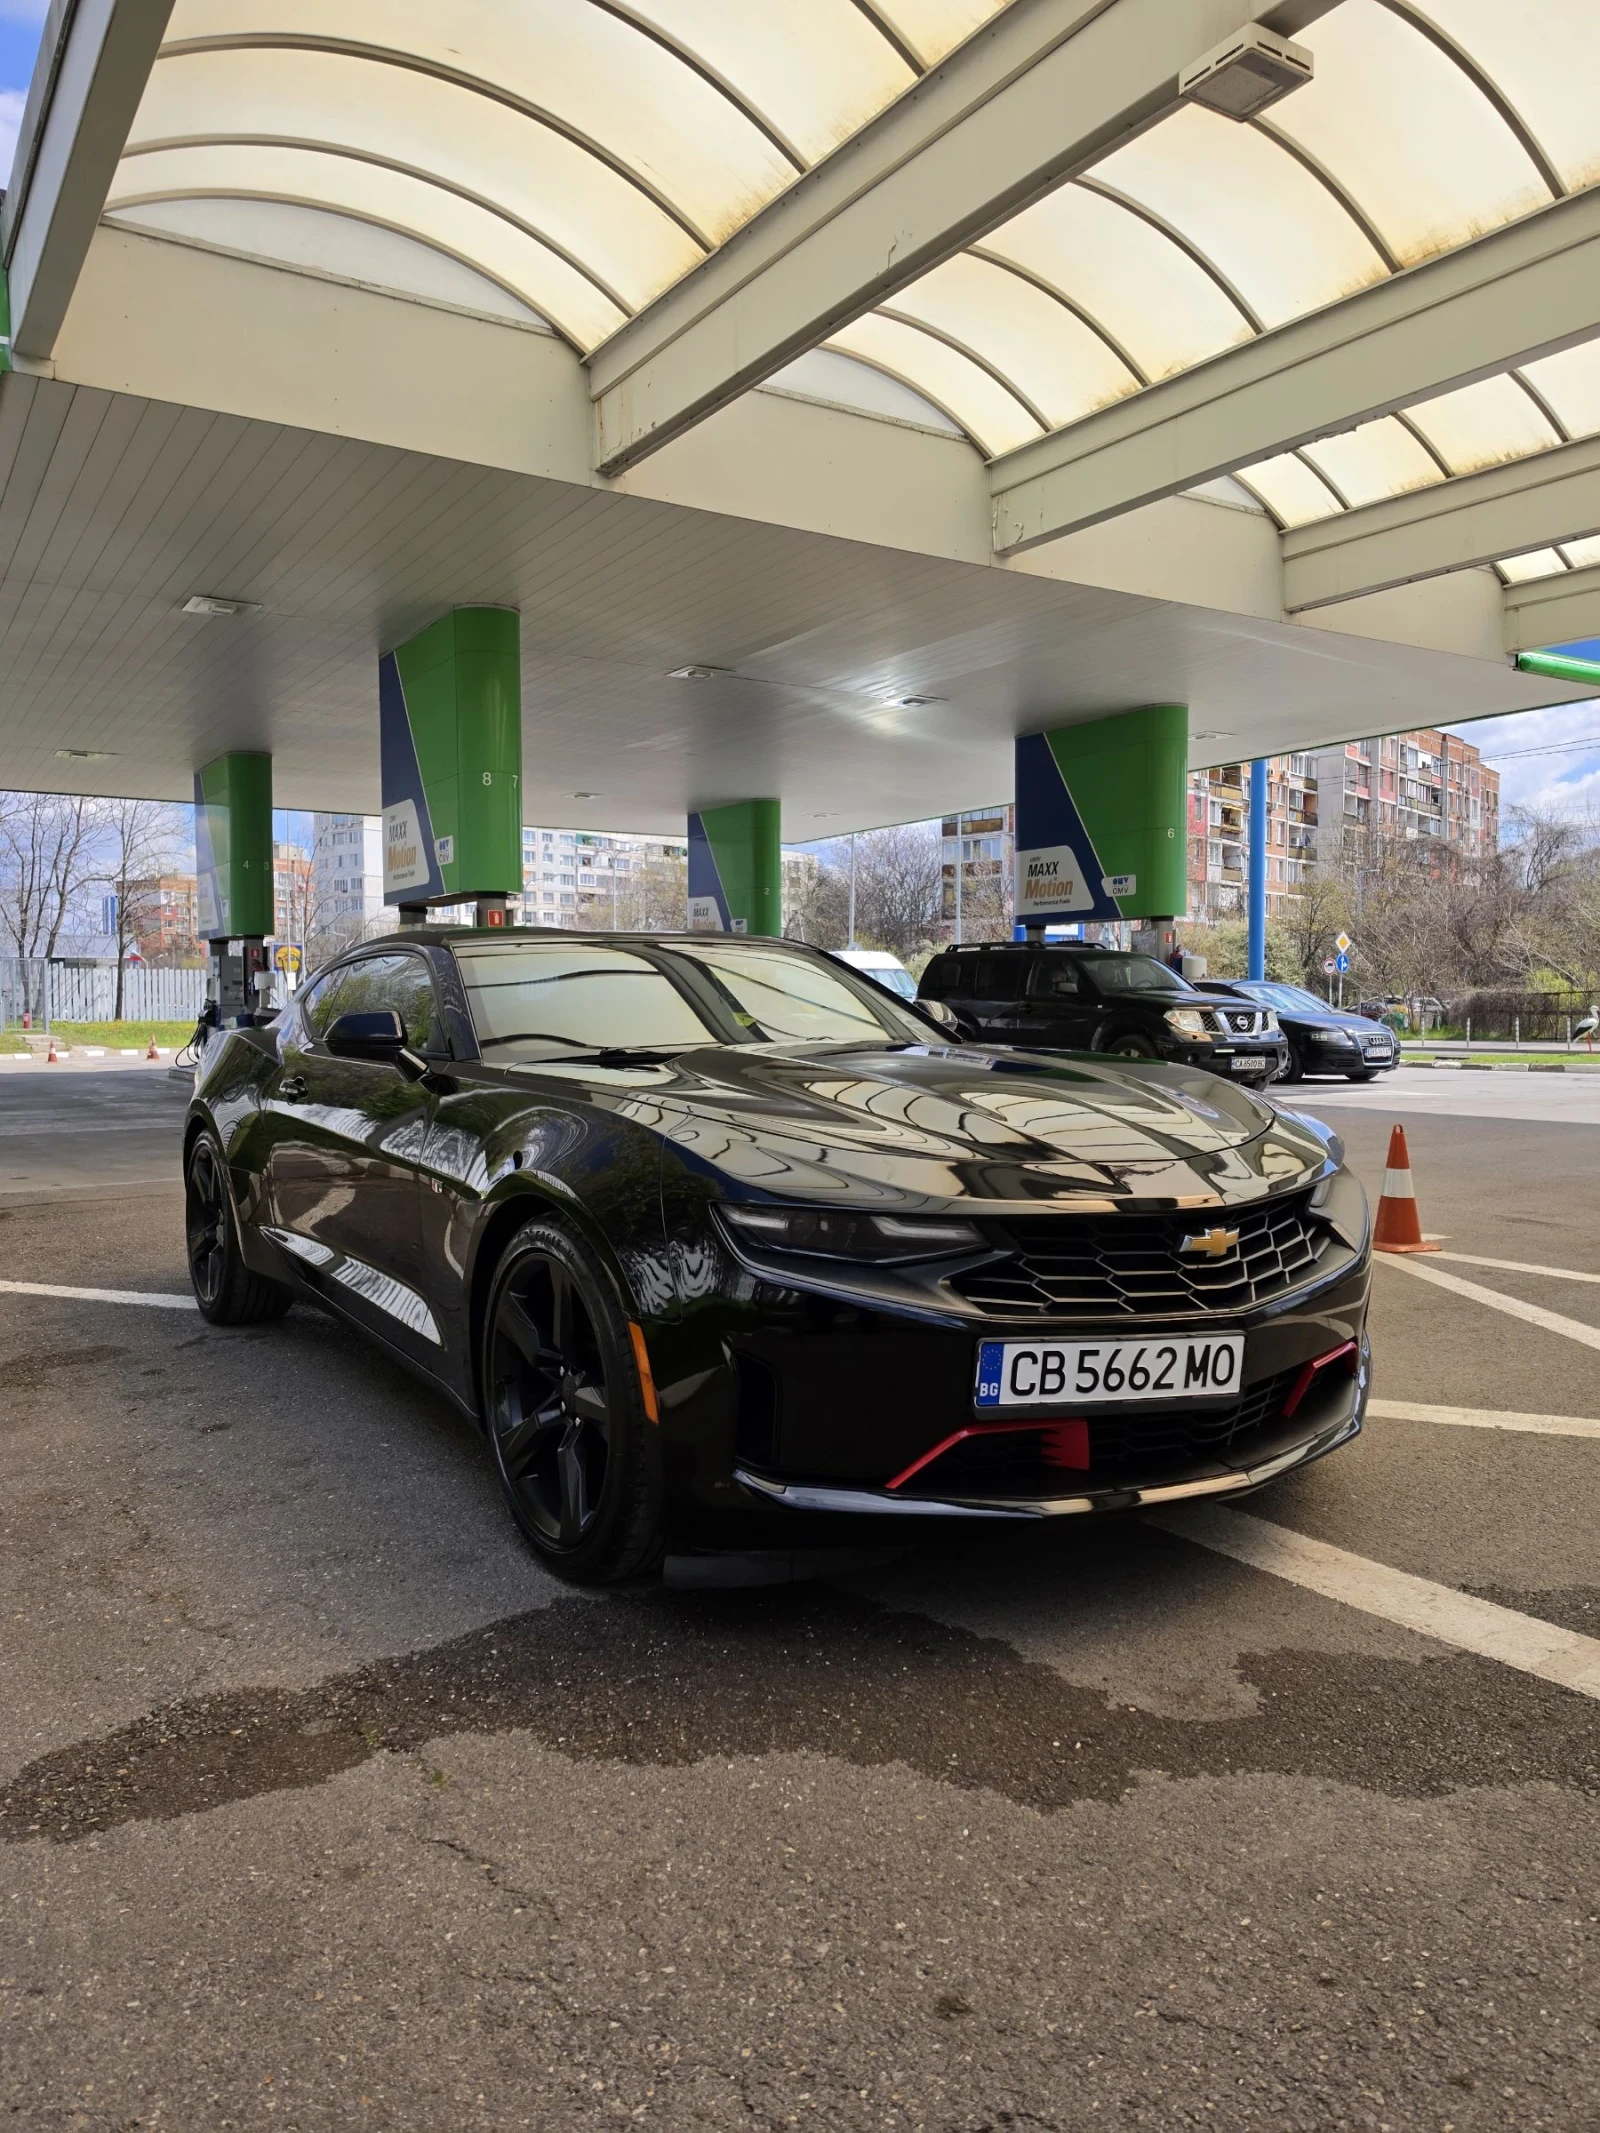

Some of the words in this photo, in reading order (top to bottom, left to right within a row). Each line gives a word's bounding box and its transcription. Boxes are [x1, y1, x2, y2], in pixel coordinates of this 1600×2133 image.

[482, 771, 492, 786] 8
[512, 774, 518, 788] 7
[389, 820, 408, 843] MAXX
[1167, 828, 1175, 839] 6
[388, 842, 417, 873] Motion
[243, 860, 249, 870] 4
[263, 861, 269, 871] 3
[1028, 861, 1059, 878] MAXX
[1025, 877, 1073, 899] Motion
[1112, 887, 1129, 895] OMV
[693, 907, 709, 917] MAXX
[1010, 1350, 1065, 1396] CB
[1075, 1346, 1178, 1393] 5662
[1183, 1343, 1235, 1389] MO
[979, 1383, 999, 1397] BG
